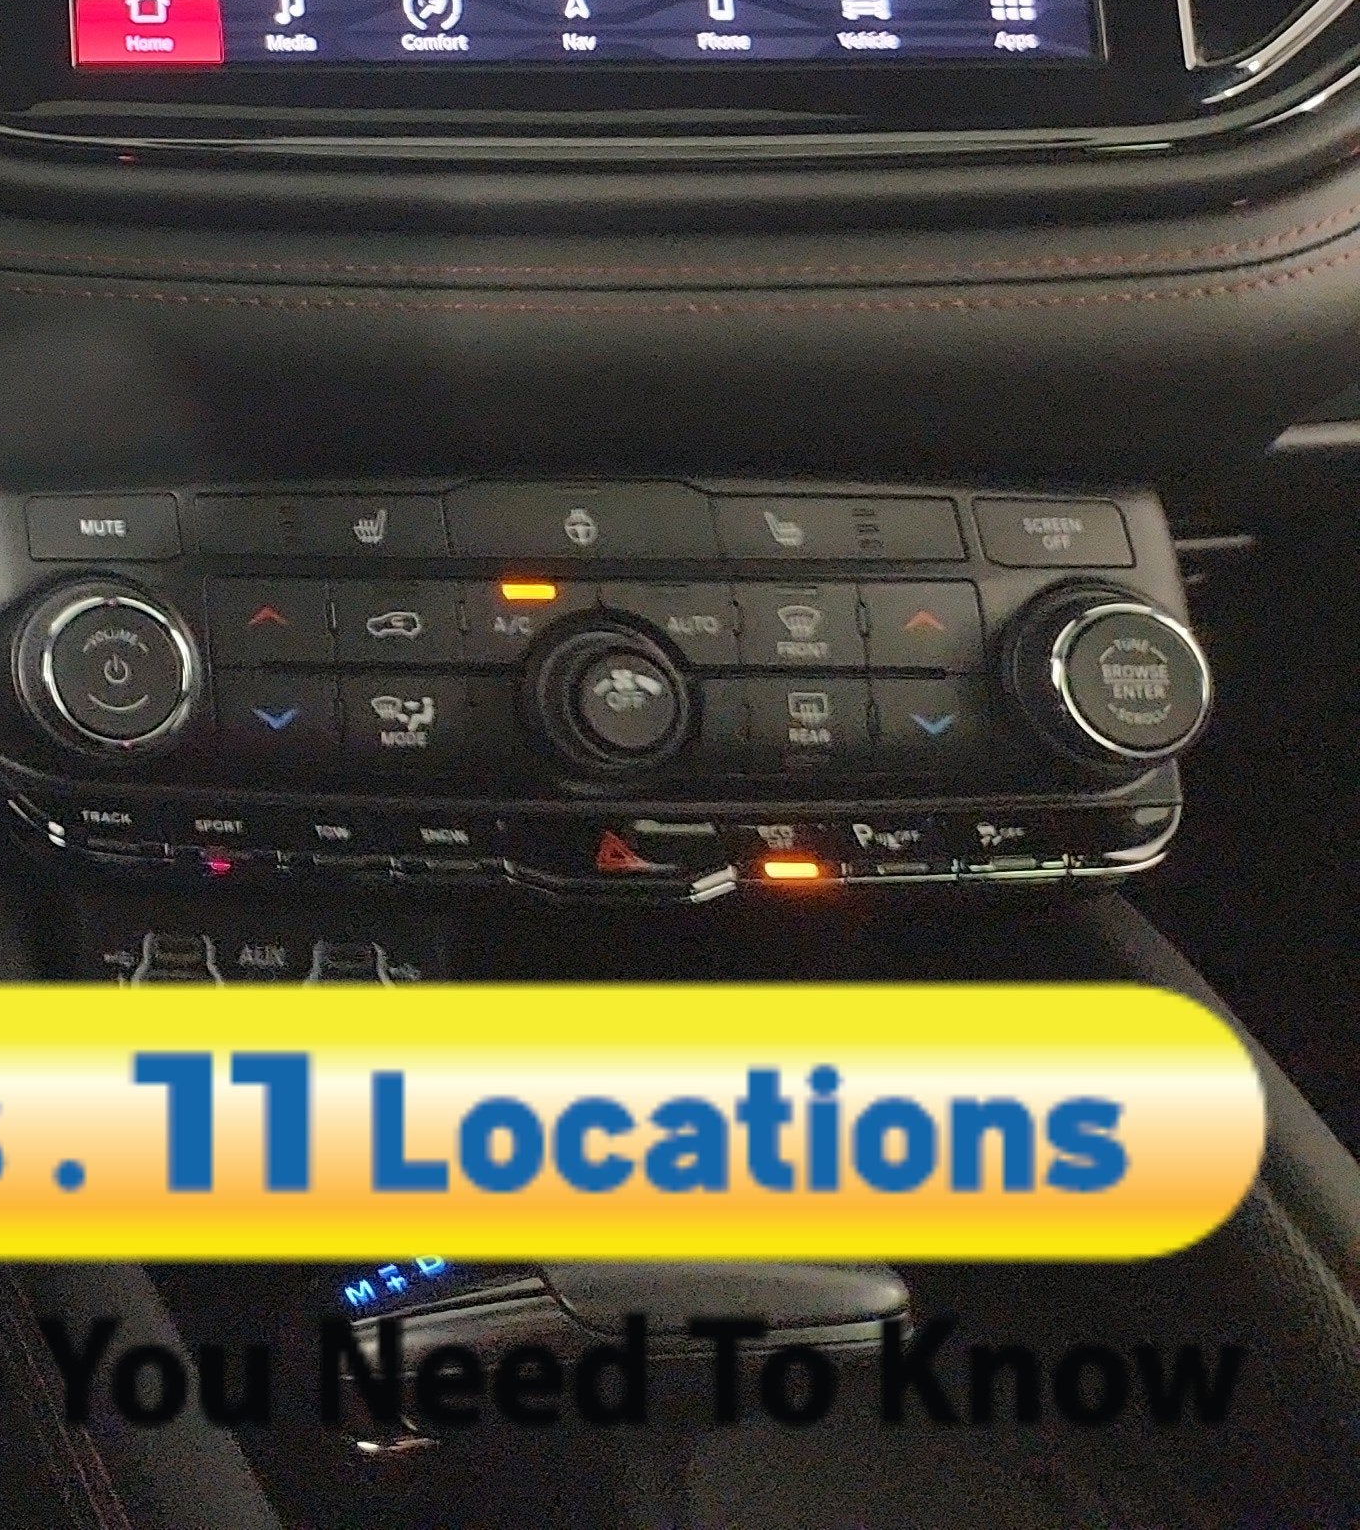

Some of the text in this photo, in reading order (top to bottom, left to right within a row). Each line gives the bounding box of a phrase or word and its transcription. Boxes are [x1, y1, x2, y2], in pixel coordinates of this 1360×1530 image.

[126, 35, 174, 53] Home
[266, 34, 317, 53] Media
[401, 33, 469, 53] Comfort
[563, 33, 597, 52] Nav
[697, 32, 752, 52] Phone
[837, 31, 901, 51] Vehicle
[994, 31, 1041, 52] Apps
[80, 519, 126, 537] MUTE
[1022, 517, 1083, 534] SCREEN
[1042, 534, 1071, 551] OFF
[1113, 682, 1166, 700] ENTER
[381, 731, 427, 747] MODE
[82, 809, 133, 825] TRACK
[195, 819, 244, 834] SPORT
